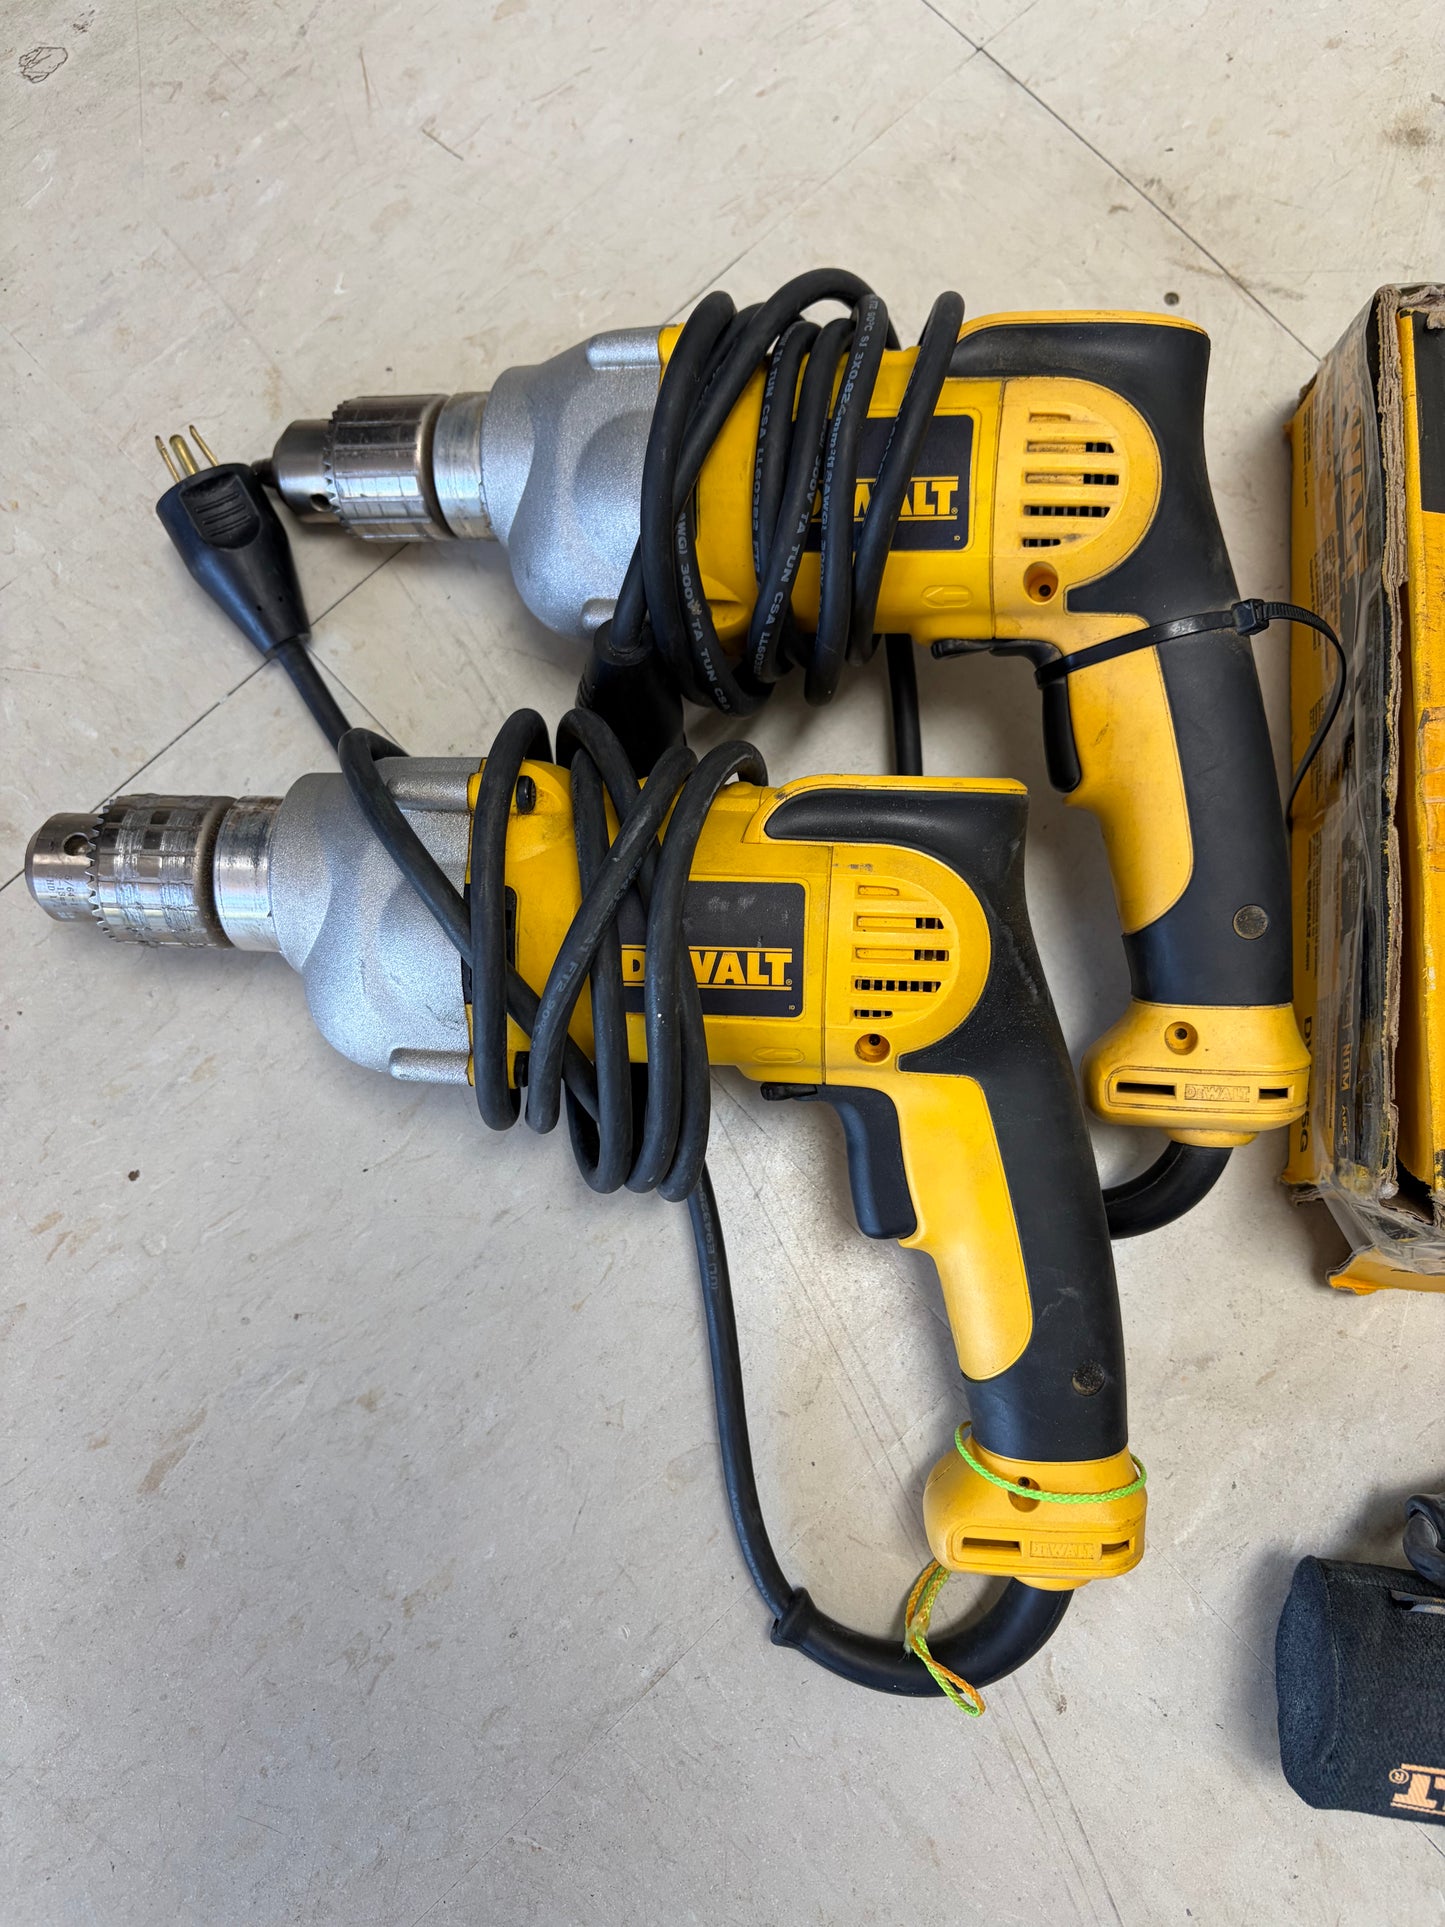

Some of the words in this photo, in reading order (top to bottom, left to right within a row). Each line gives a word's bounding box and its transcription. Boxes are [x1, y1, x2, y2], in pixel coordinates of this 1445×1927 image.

[759, 404, 771, 439] CSA
[796, 511, 810, 534] TA
[780, 544, 801, 583] TUN
[765, 591, 784, 625] CSA
[692, 619, 704, 642] TA
[701, 648, 718, 683] TUN
